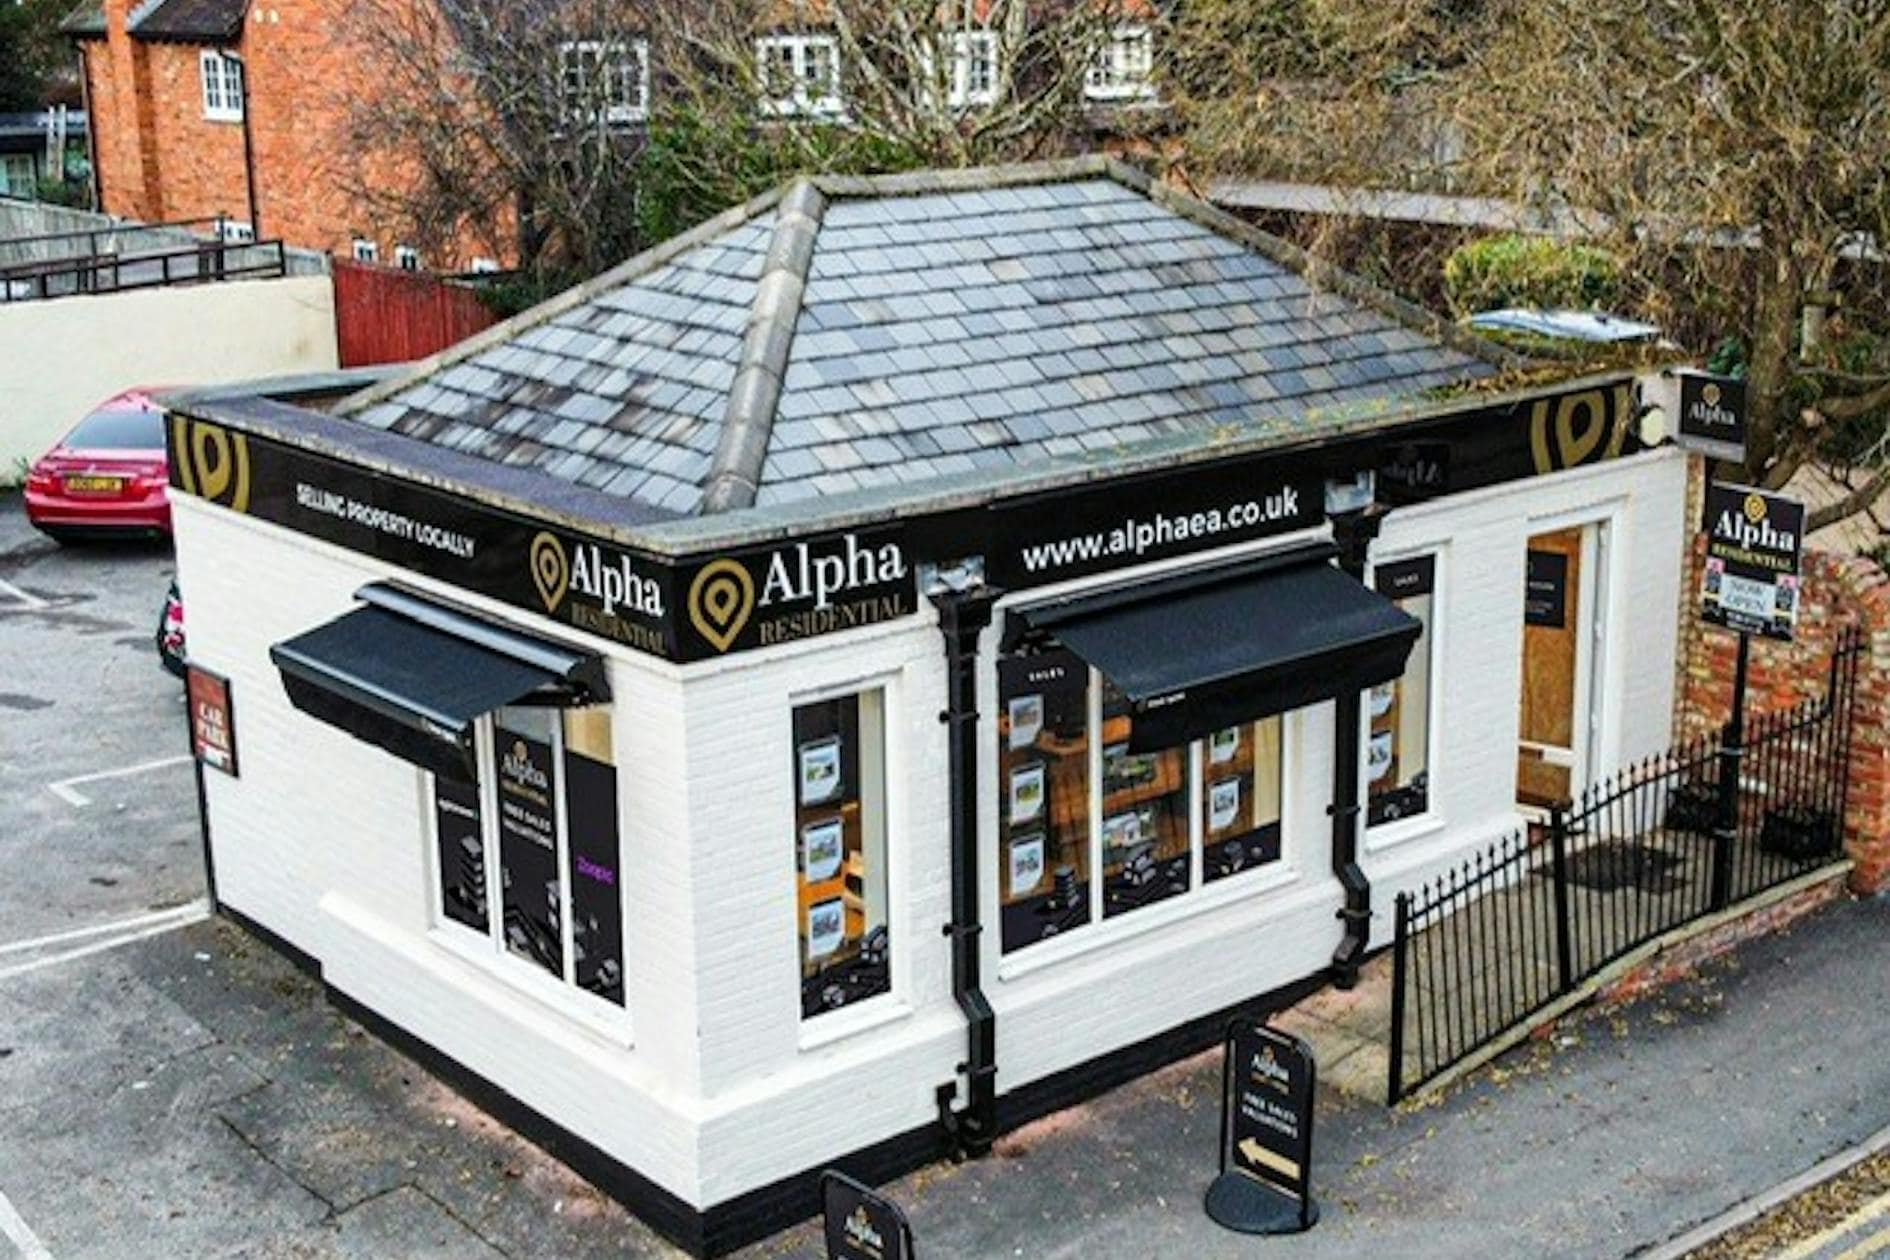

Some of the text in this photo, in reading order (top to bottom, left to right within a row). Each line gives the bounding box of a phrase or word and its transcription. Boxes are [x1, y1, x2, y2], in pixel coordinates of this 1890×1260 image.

[1689, 402, 1736, 425] Alpha
[296, 483, 475, 558] SELLING PROPERTY LOCALLY
[1022, 485, 1300, 572] www.alphaea.co.uk
[1714, 509, 1796, 551] Alpha
[569, 543, 665, 618] Alpha
[758, 534, 908, 611] Alpha
[760, 593, 909, 645] RESIDENTIAL
[1724, 592, 1766, 613] OPEN
[571, 603, 668, 655] RESIDENTIAL
[198, 701, 224, 726] CAR
[196, 719, 229, 751] PARK
[503, 754, 548, 788] Alpha
[1251, 1053, 1290, 1082] Alpha
